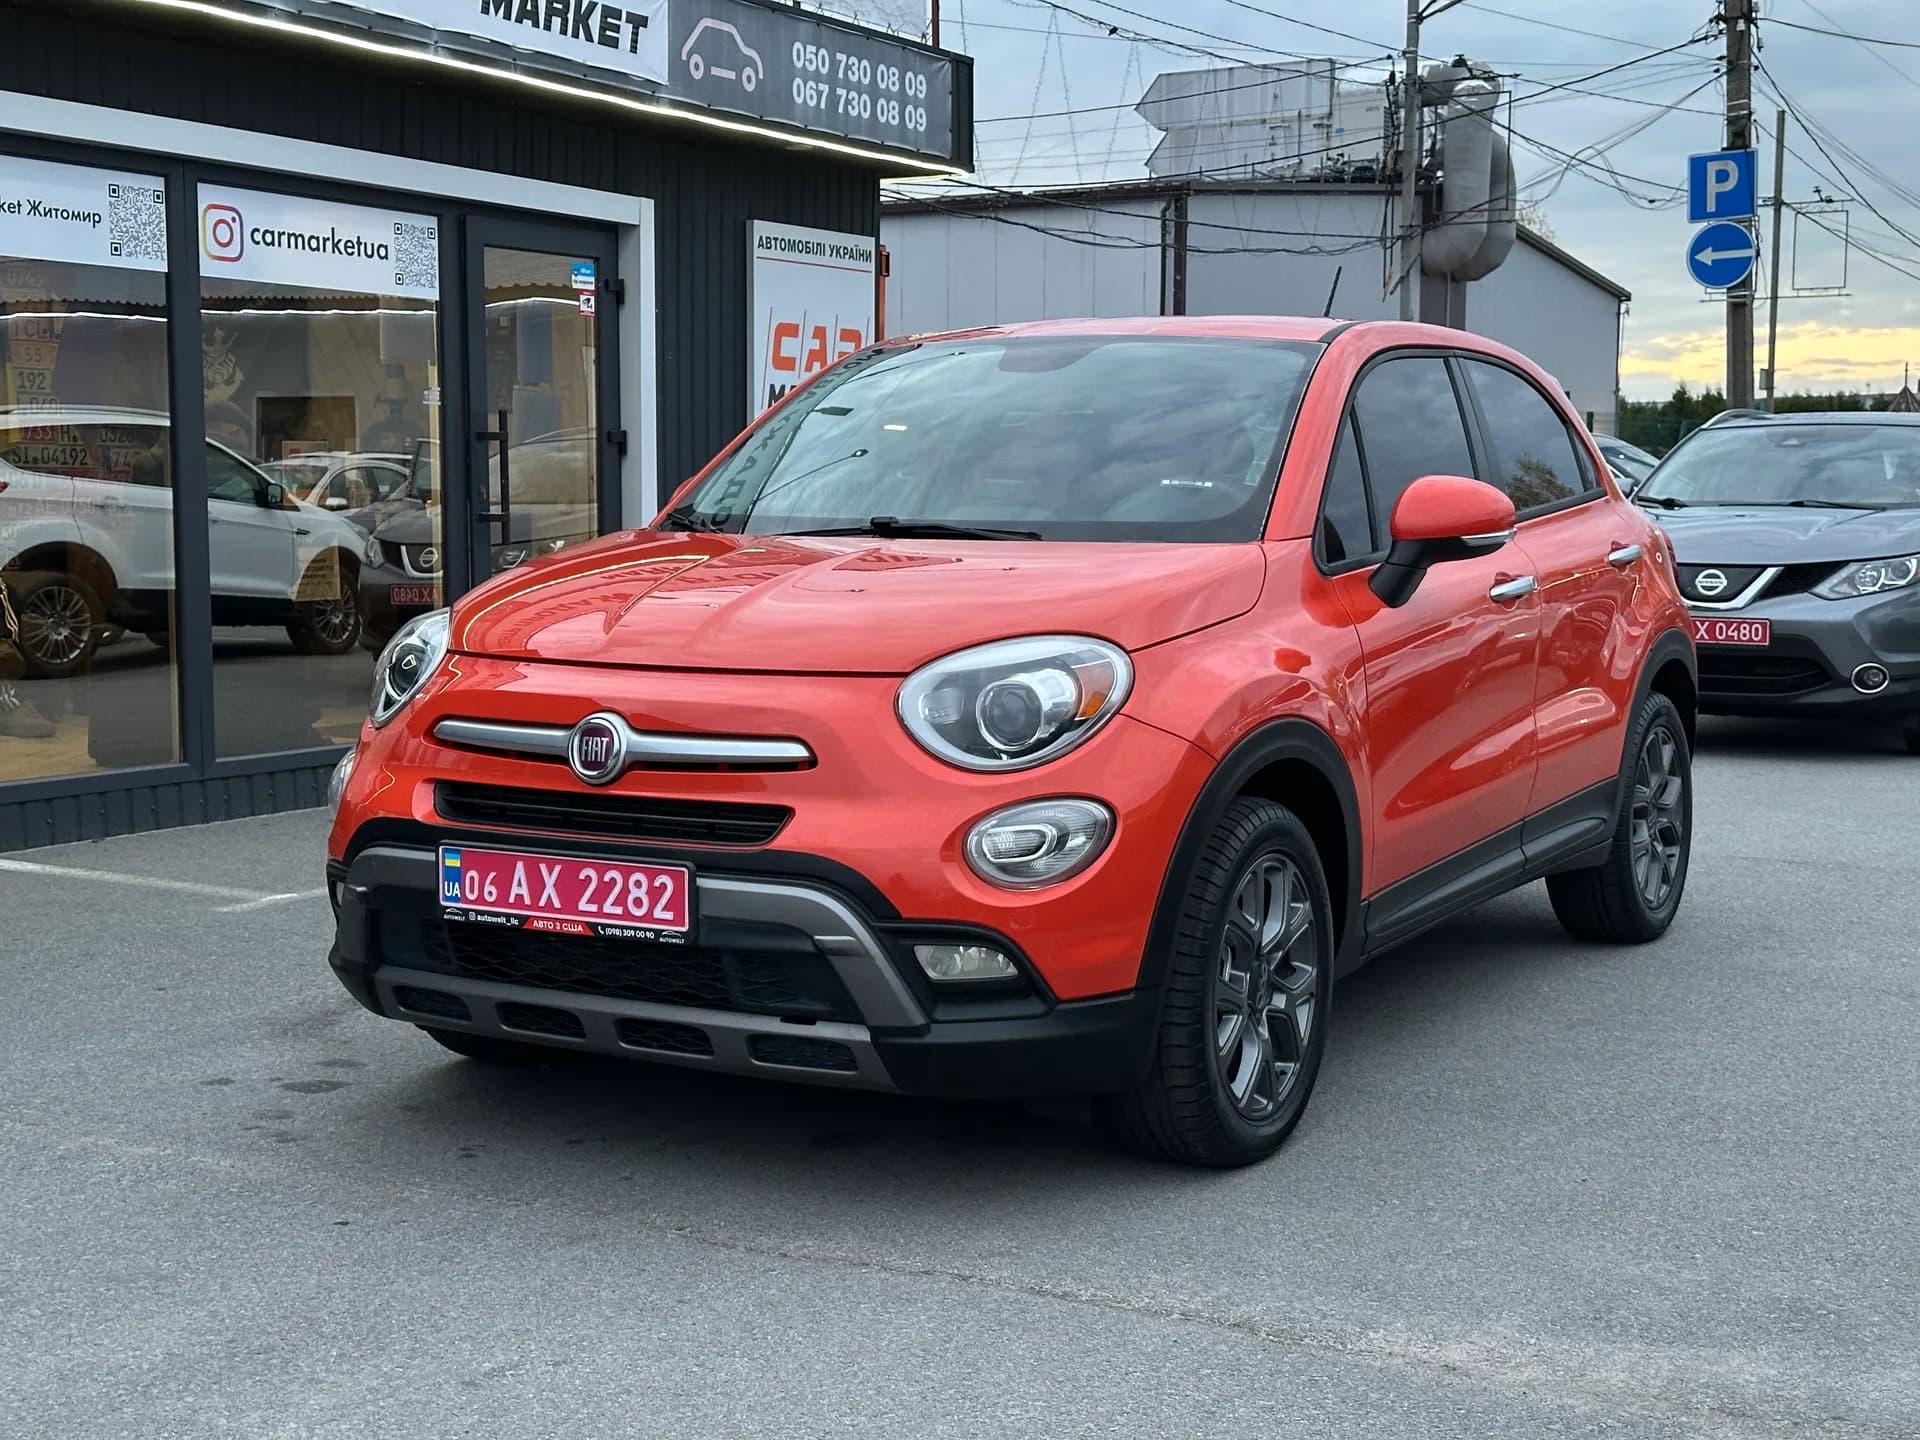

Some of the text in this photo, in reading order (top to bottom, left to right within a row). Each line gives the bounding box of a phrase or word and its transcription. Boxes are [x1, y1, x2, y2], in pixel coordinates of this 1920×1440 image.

[792, 41, 927, 98] 050 730 08 09
[792, 77, 927, 132] 067 730 08 09
[1706, 160, 1739, 212] P
[26, 198, 102, 228] Житомир
[250, 227, 389, 260] carmarketua
[757, 235, 873, 264] АВТОМОБІЛІ УКРАЇНИ
[17, 370, 47, 390] 192
[1715, 622, 1762, 641] 0480
[581, 736, 609, 762] FIAT
[444, 881, 461, 898] UA
[465, 861, 674, 921] 06 AX 2282
[533, 919, 554, 929] АВТО
[561, 923, 584, 933] США
[636, 930, 645, 938] 00
[645, 931, 655, 939] 90
